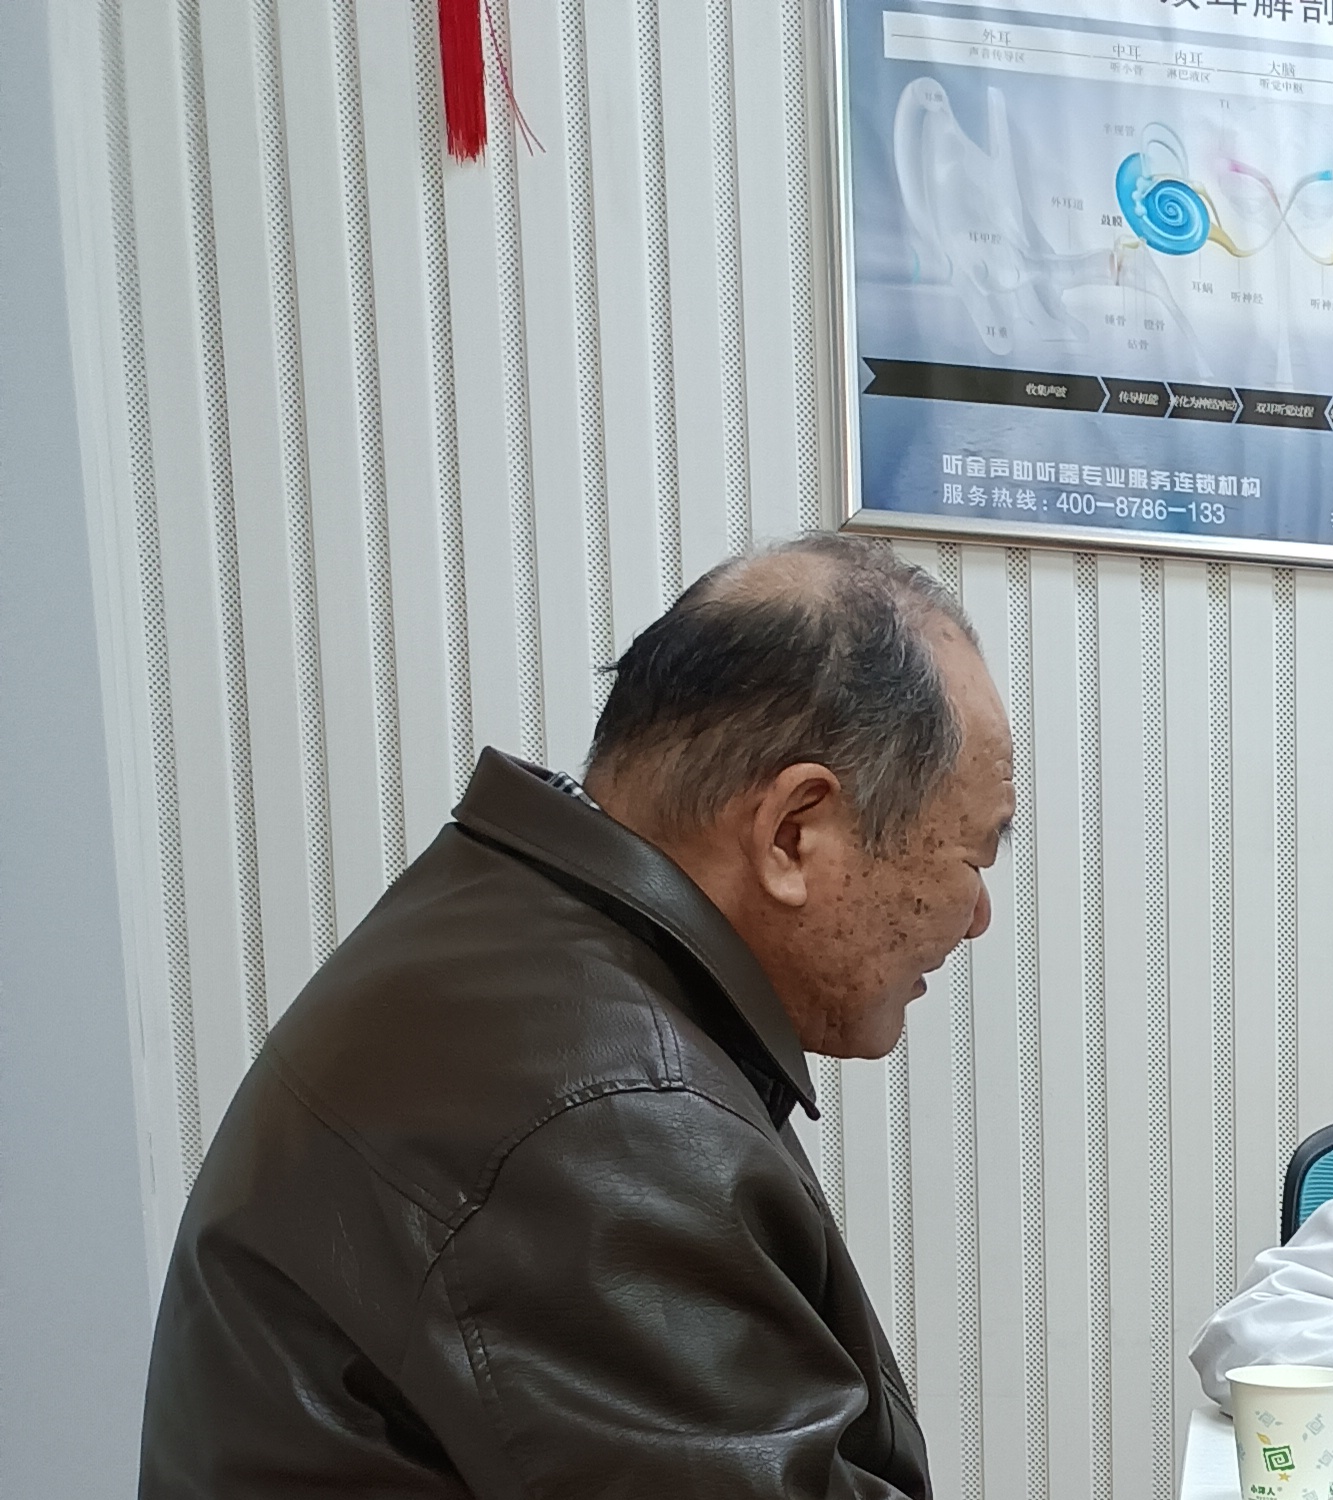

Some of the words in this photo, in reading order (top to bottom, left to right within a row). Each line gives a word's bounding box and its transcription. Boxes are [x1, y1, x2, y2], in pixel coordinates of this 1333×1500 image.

[983, 29, 1011, 45] 外耳
[968, 46, 1025, 63] 声音传导区
[1112, 45, 1142, 61] 中耳
[1174, 51, 1204, 66] 内耳
[1110, 62, 1144, 77] 听小骨
[1166, 68, 1211, 83] 淋巴液区
[1268, 61, 1296, 78] 大脑
[1259, 78, 1304, 95] 听觉中枢
[1025, 383, 1068, 399] 收集声波
[1119, 390, 1159, 406] 传导机能
[1255, 401, 1315, 419] 双耳听觉过程
[942, 454, 1262, 499] 听金声助听器专业服务连锁机构
